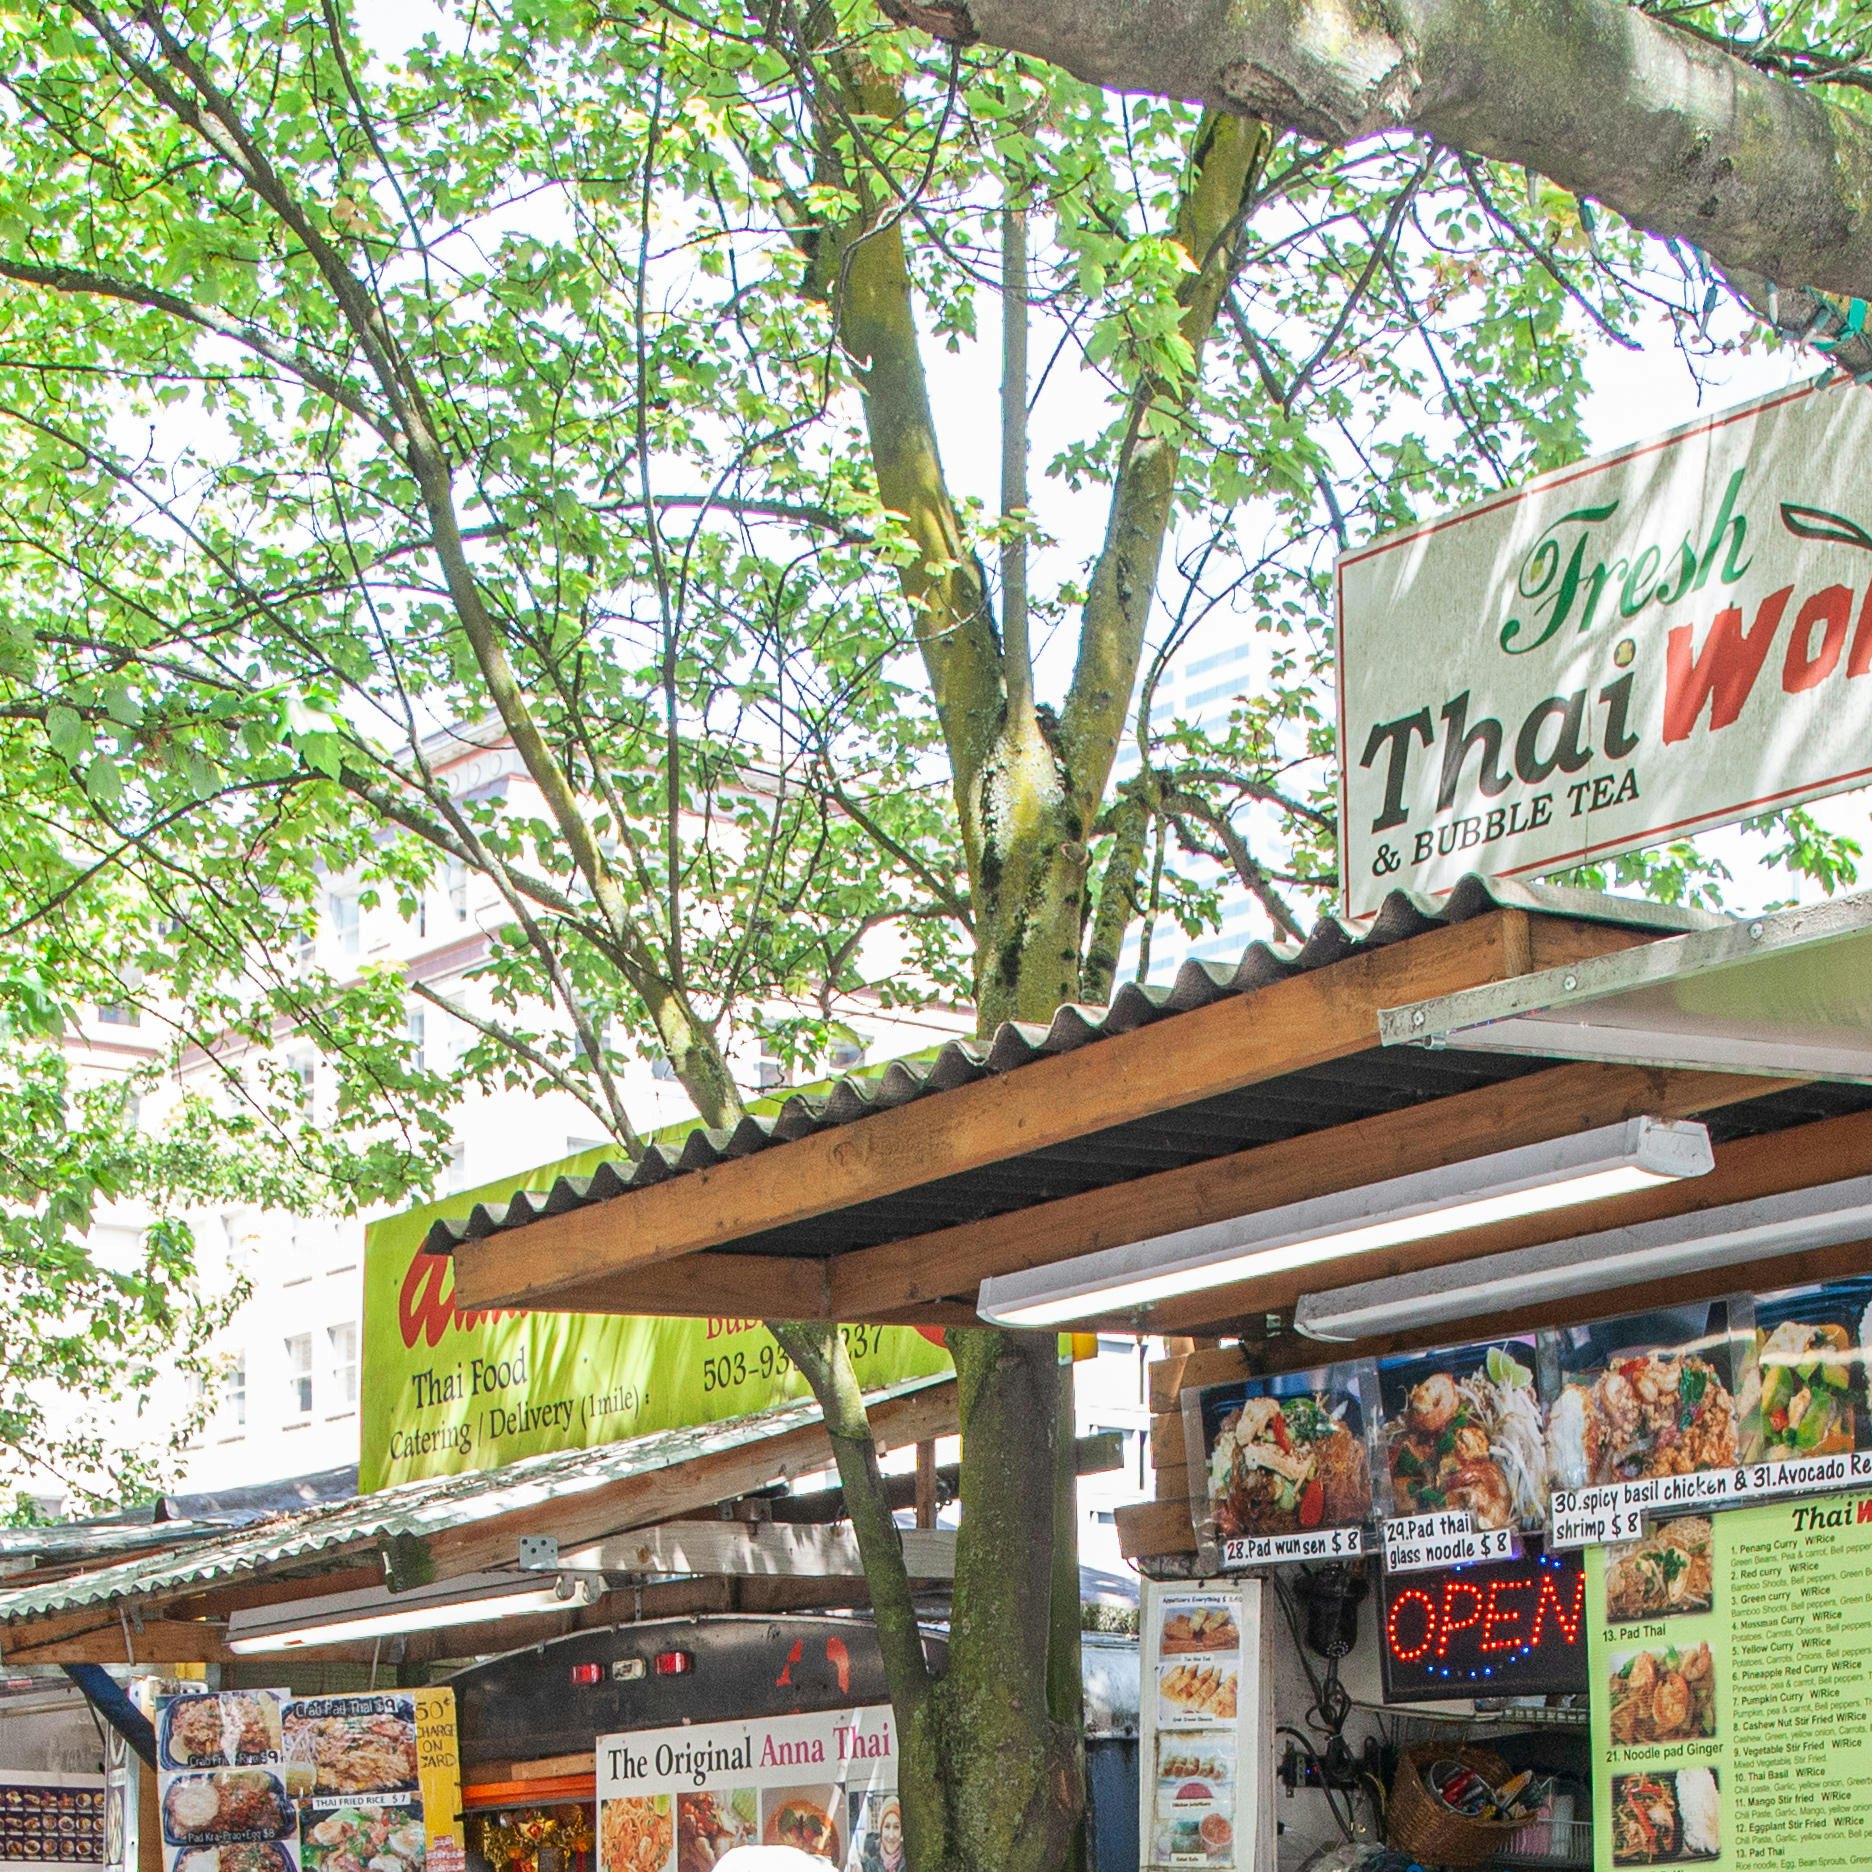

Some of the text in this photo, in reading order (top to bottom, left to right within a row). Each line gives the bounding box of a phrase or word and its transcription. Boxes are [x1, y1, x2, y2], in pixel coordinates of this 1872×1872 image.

[1500, 469, 1753, 655] Fresh
[1360, 638, 1640, 835] Thai
[1372, 768, 1641, 877] & BUBBLE TEA
[412, 1345, 527, 1410] Thai Food
[390, 1416, 472, 1461] Catering
[490, 1398, 575, 1441] Delivery
[1554, 1470, 1747, 1515] 30.spicy basil chicken &
[1753, 1460, 1845, 1488] 31.Avocado
[1387, 1514, 1470, 1543] 29.Pad thai
[1556, 1512, 1639, 1541] shrimp $ 8
[1791, 1501, 1853, 1532] Thai
[1228, 1540, 1271, 1561] 28.Pad
[1332, 1531, 1342, 1553] $
[1348, 1531, 1359, 1550] 8
[1390, 1532, 1508, 1570] glass noodle $ 8
[1388, 1573, 1588, 1661] OPEN
[423, 1740, 444, 1753] ON
[608, 1722, 891, 1786] The Original Anna Thai
[316, 1795, 385, 1807] THAI FRIED RICE
